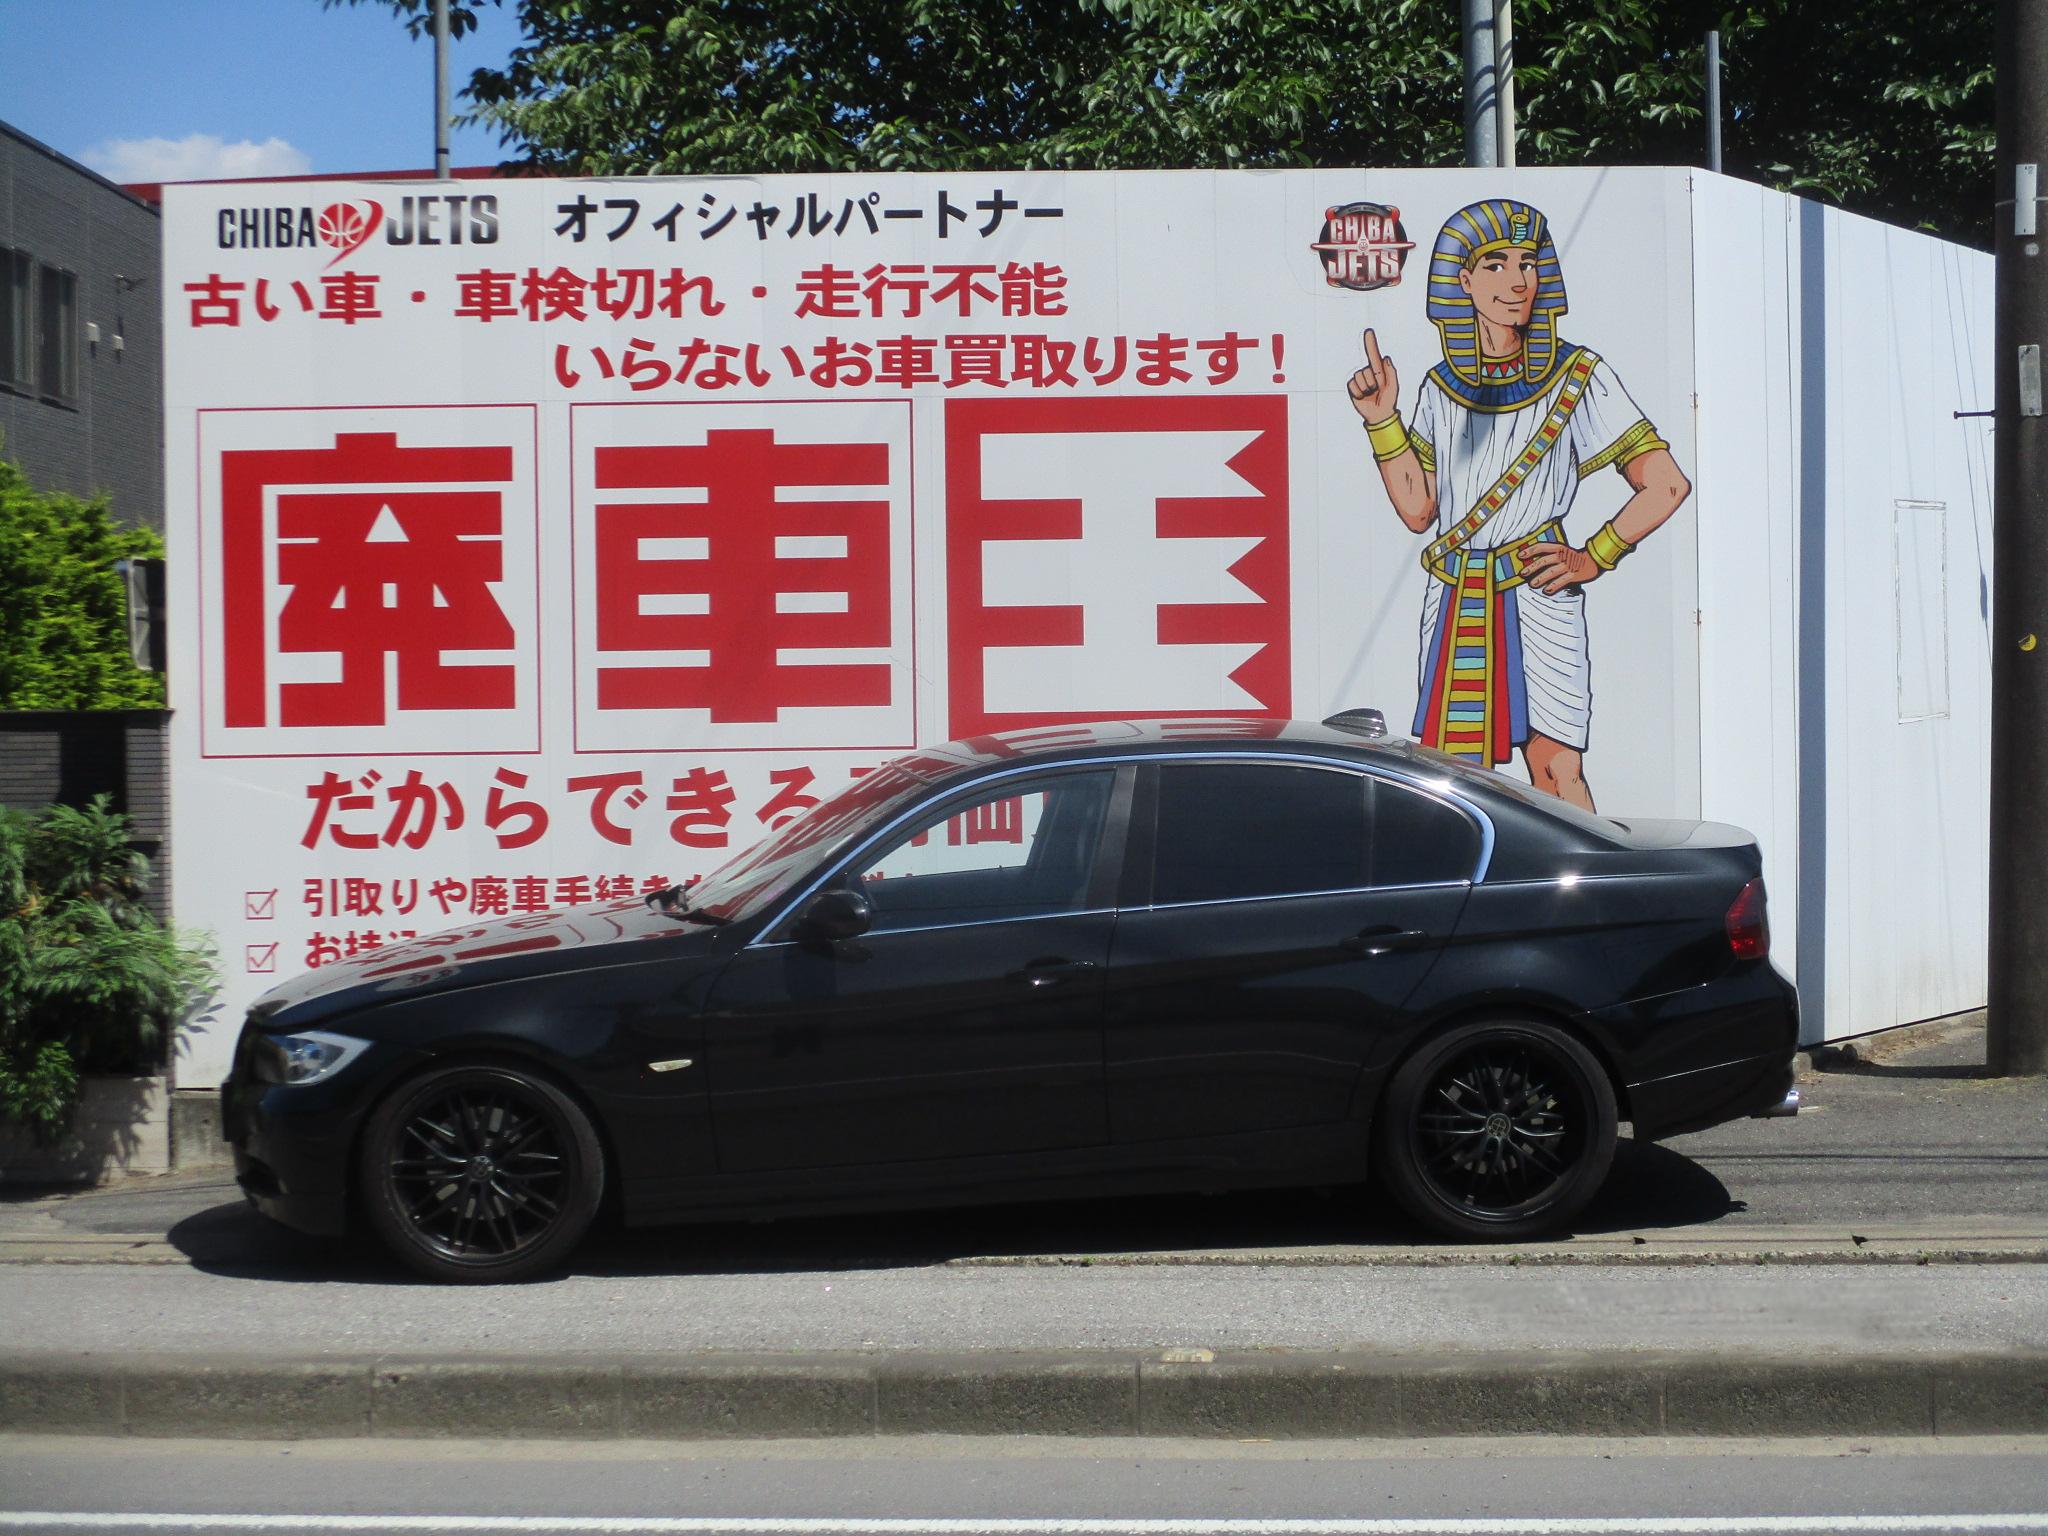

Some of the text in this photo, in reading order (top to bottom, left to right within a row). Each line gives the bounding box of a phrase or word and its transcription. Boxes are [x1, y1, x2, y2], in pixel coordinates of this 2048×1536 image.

[219, 195, 498, 249] CHIBA JETS
[555, 189, 1064, 242] オフィシャルパートナー
[1330, 215, 1396, 242] CHIBA
[1328, 249, 1399, 282] JETS
[184, 261, 1068, 327] 古い車・車検切れ・走行不能
[555, 331, 1285, 391] いらないお車買取ります!
[304, 873, 702, 917] 引取りや廃車手続
[305, 930, 416, 969] お持
